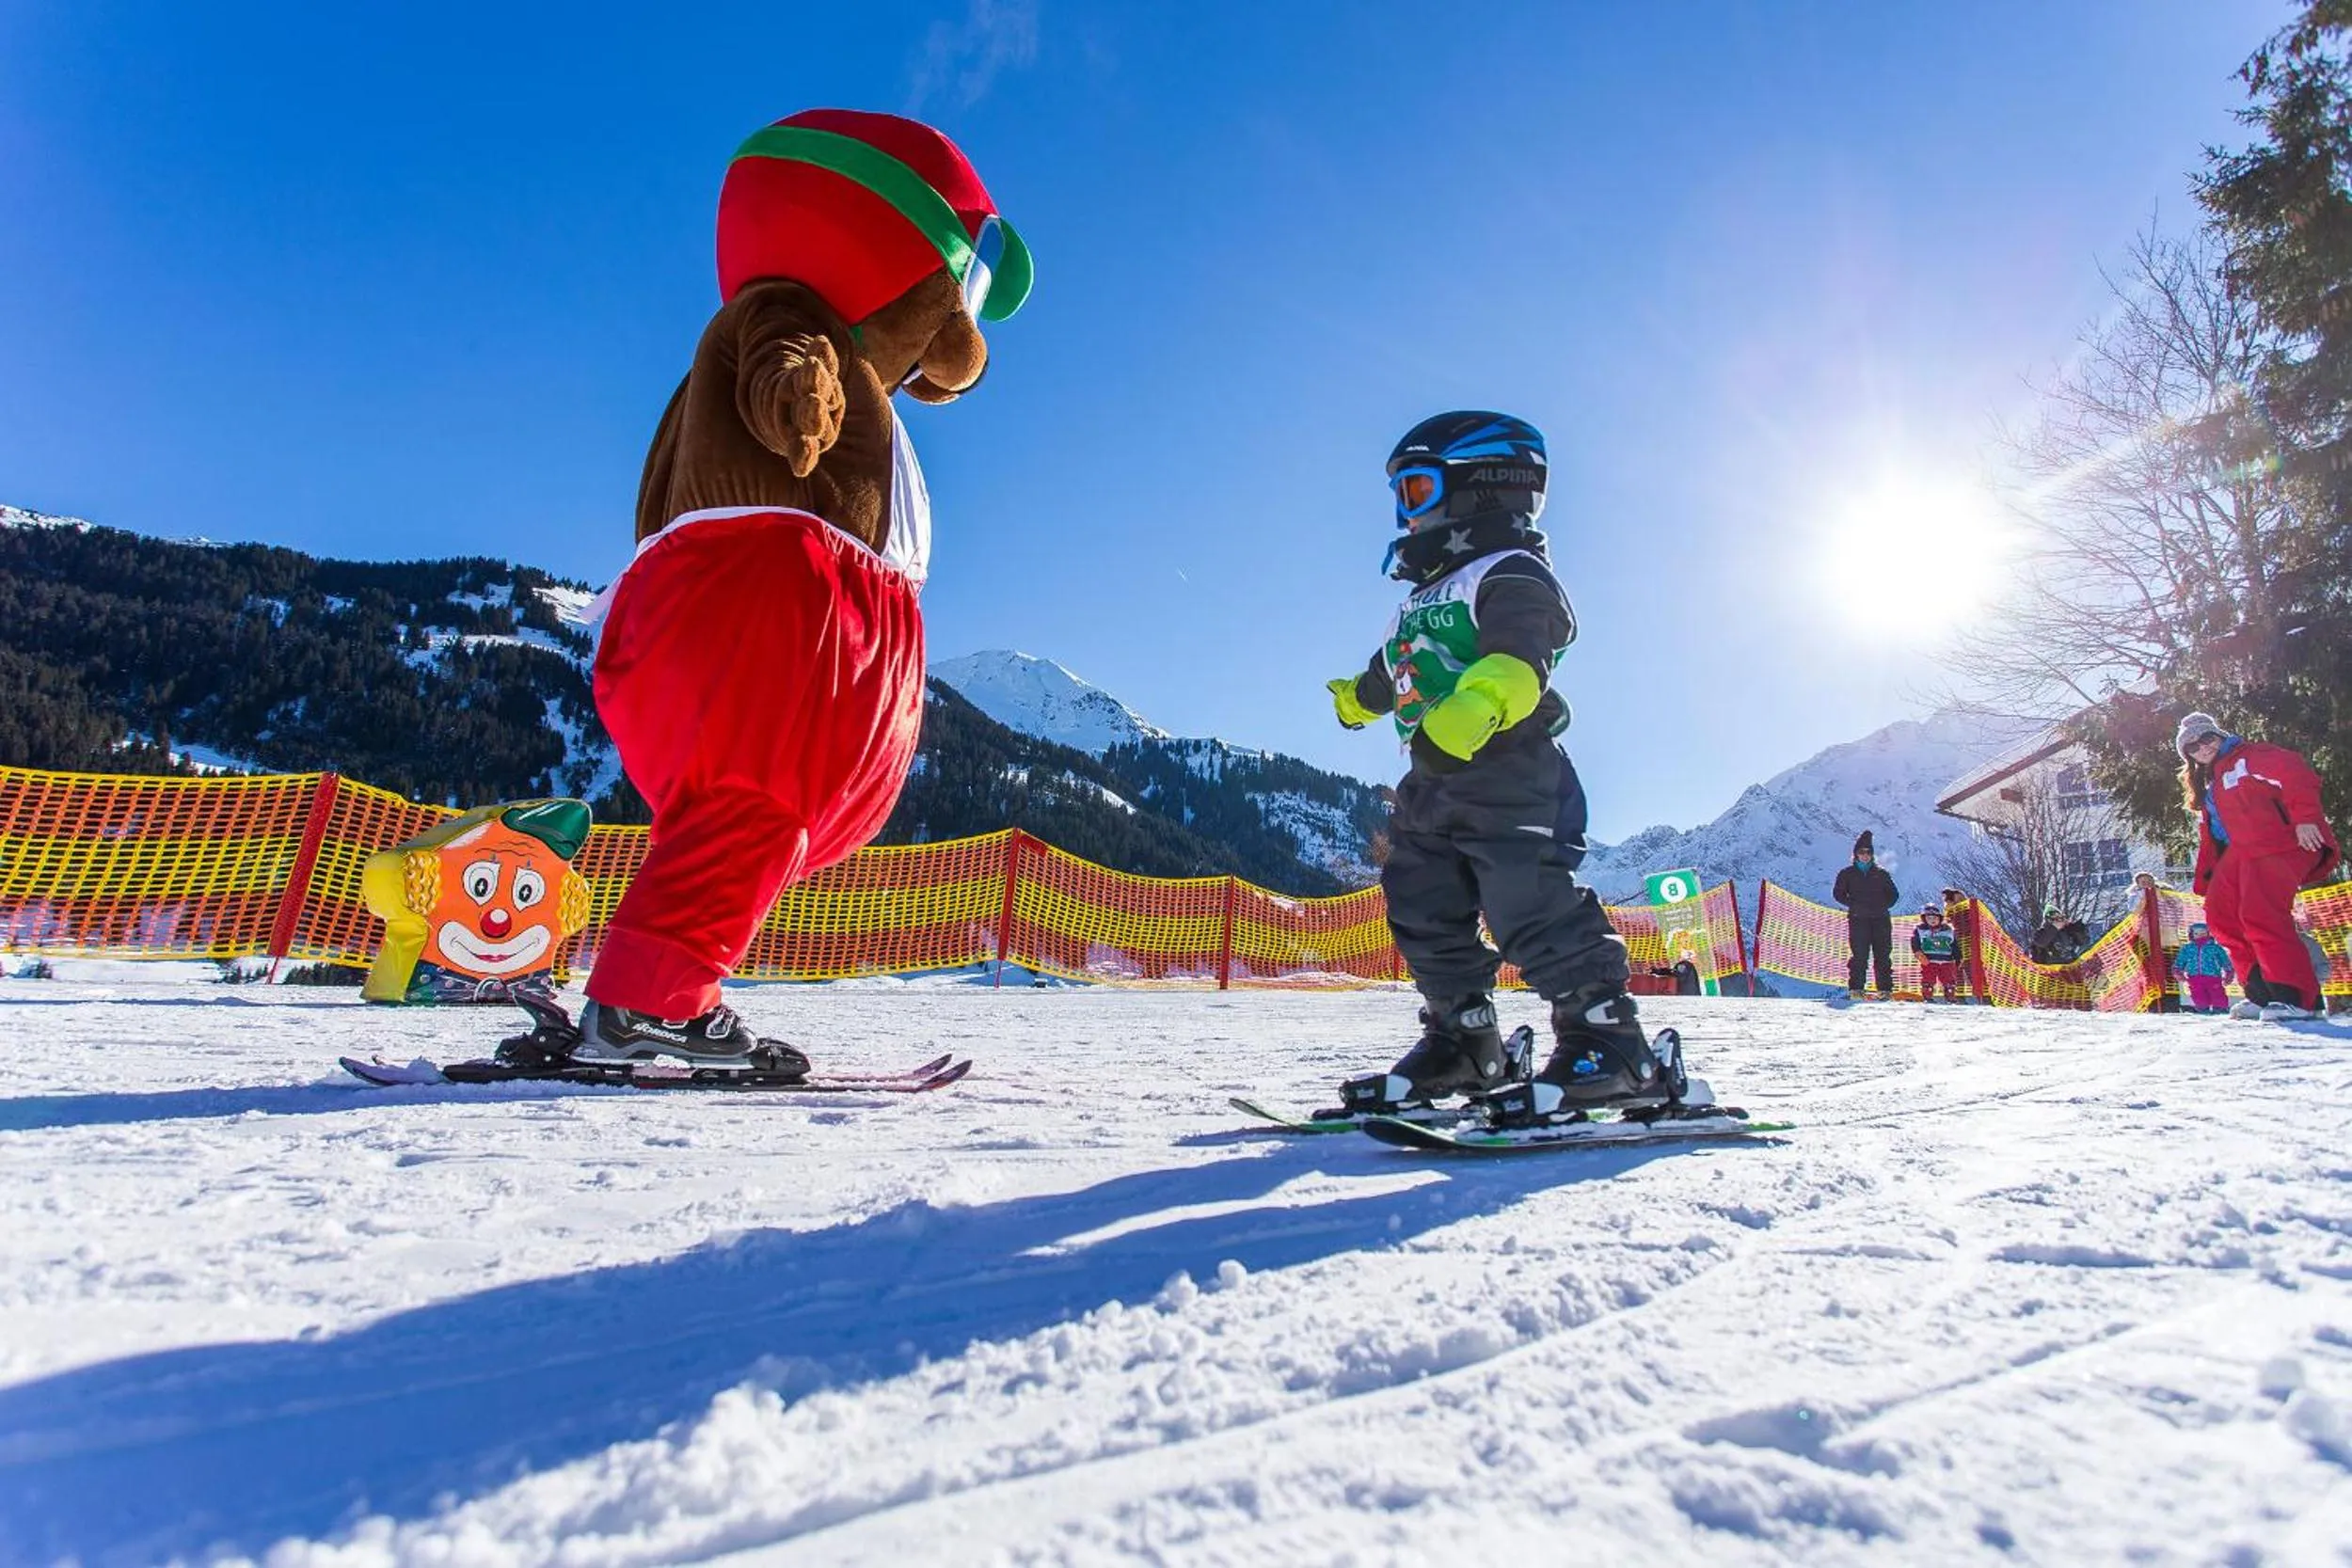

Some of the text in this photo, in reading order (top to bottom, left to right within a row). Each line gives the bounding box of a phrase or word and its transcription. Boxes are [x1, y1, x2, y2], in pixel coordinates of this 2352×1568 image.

[1468, 467, 1541, 485] ALPINA
[1667, 882, 1679, 896] 8
[631, 1022, 689, 1043] NORDICA
